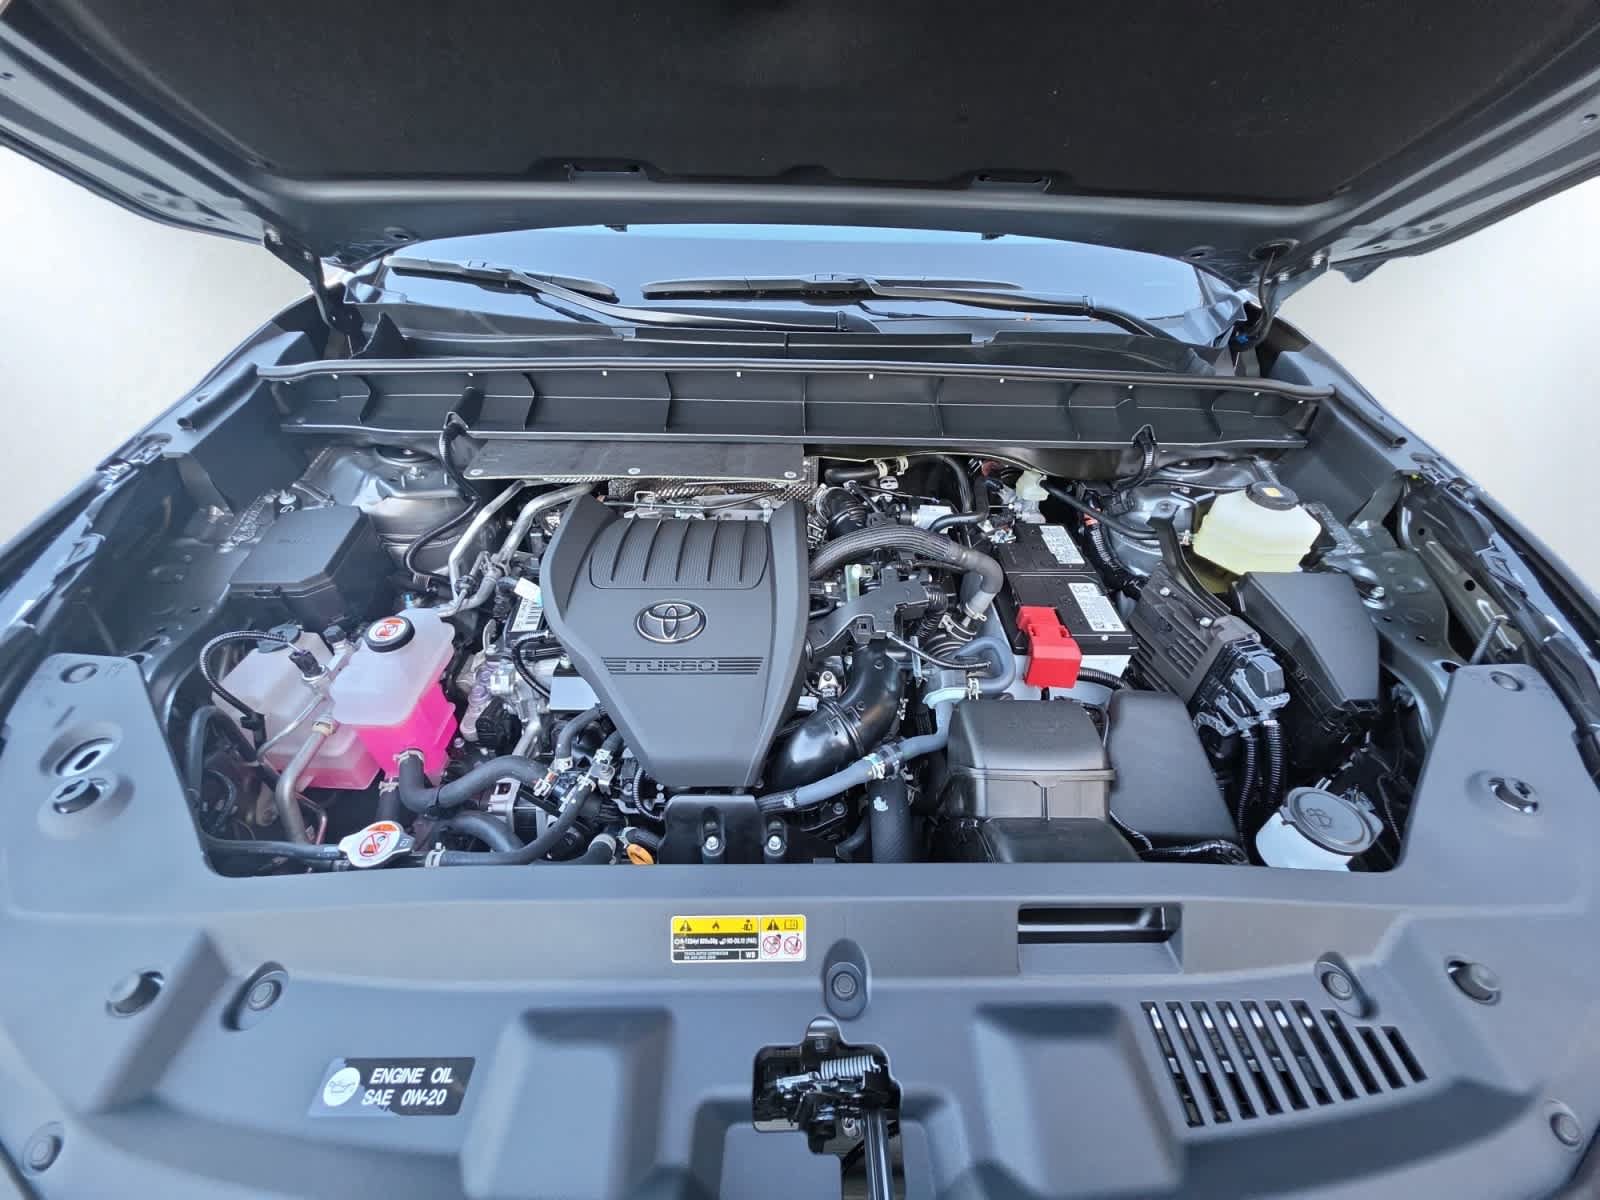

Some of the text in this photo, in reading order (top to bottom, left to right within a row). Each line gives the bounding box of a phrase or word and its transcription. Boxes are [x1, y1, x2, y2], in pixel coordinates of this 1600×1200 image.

[628, 660, 715, 671] TURBO
[369, 1066, 454, 1084] ENGINE OIL
[361, 1088, 448, 1106] SAE 0W-20
